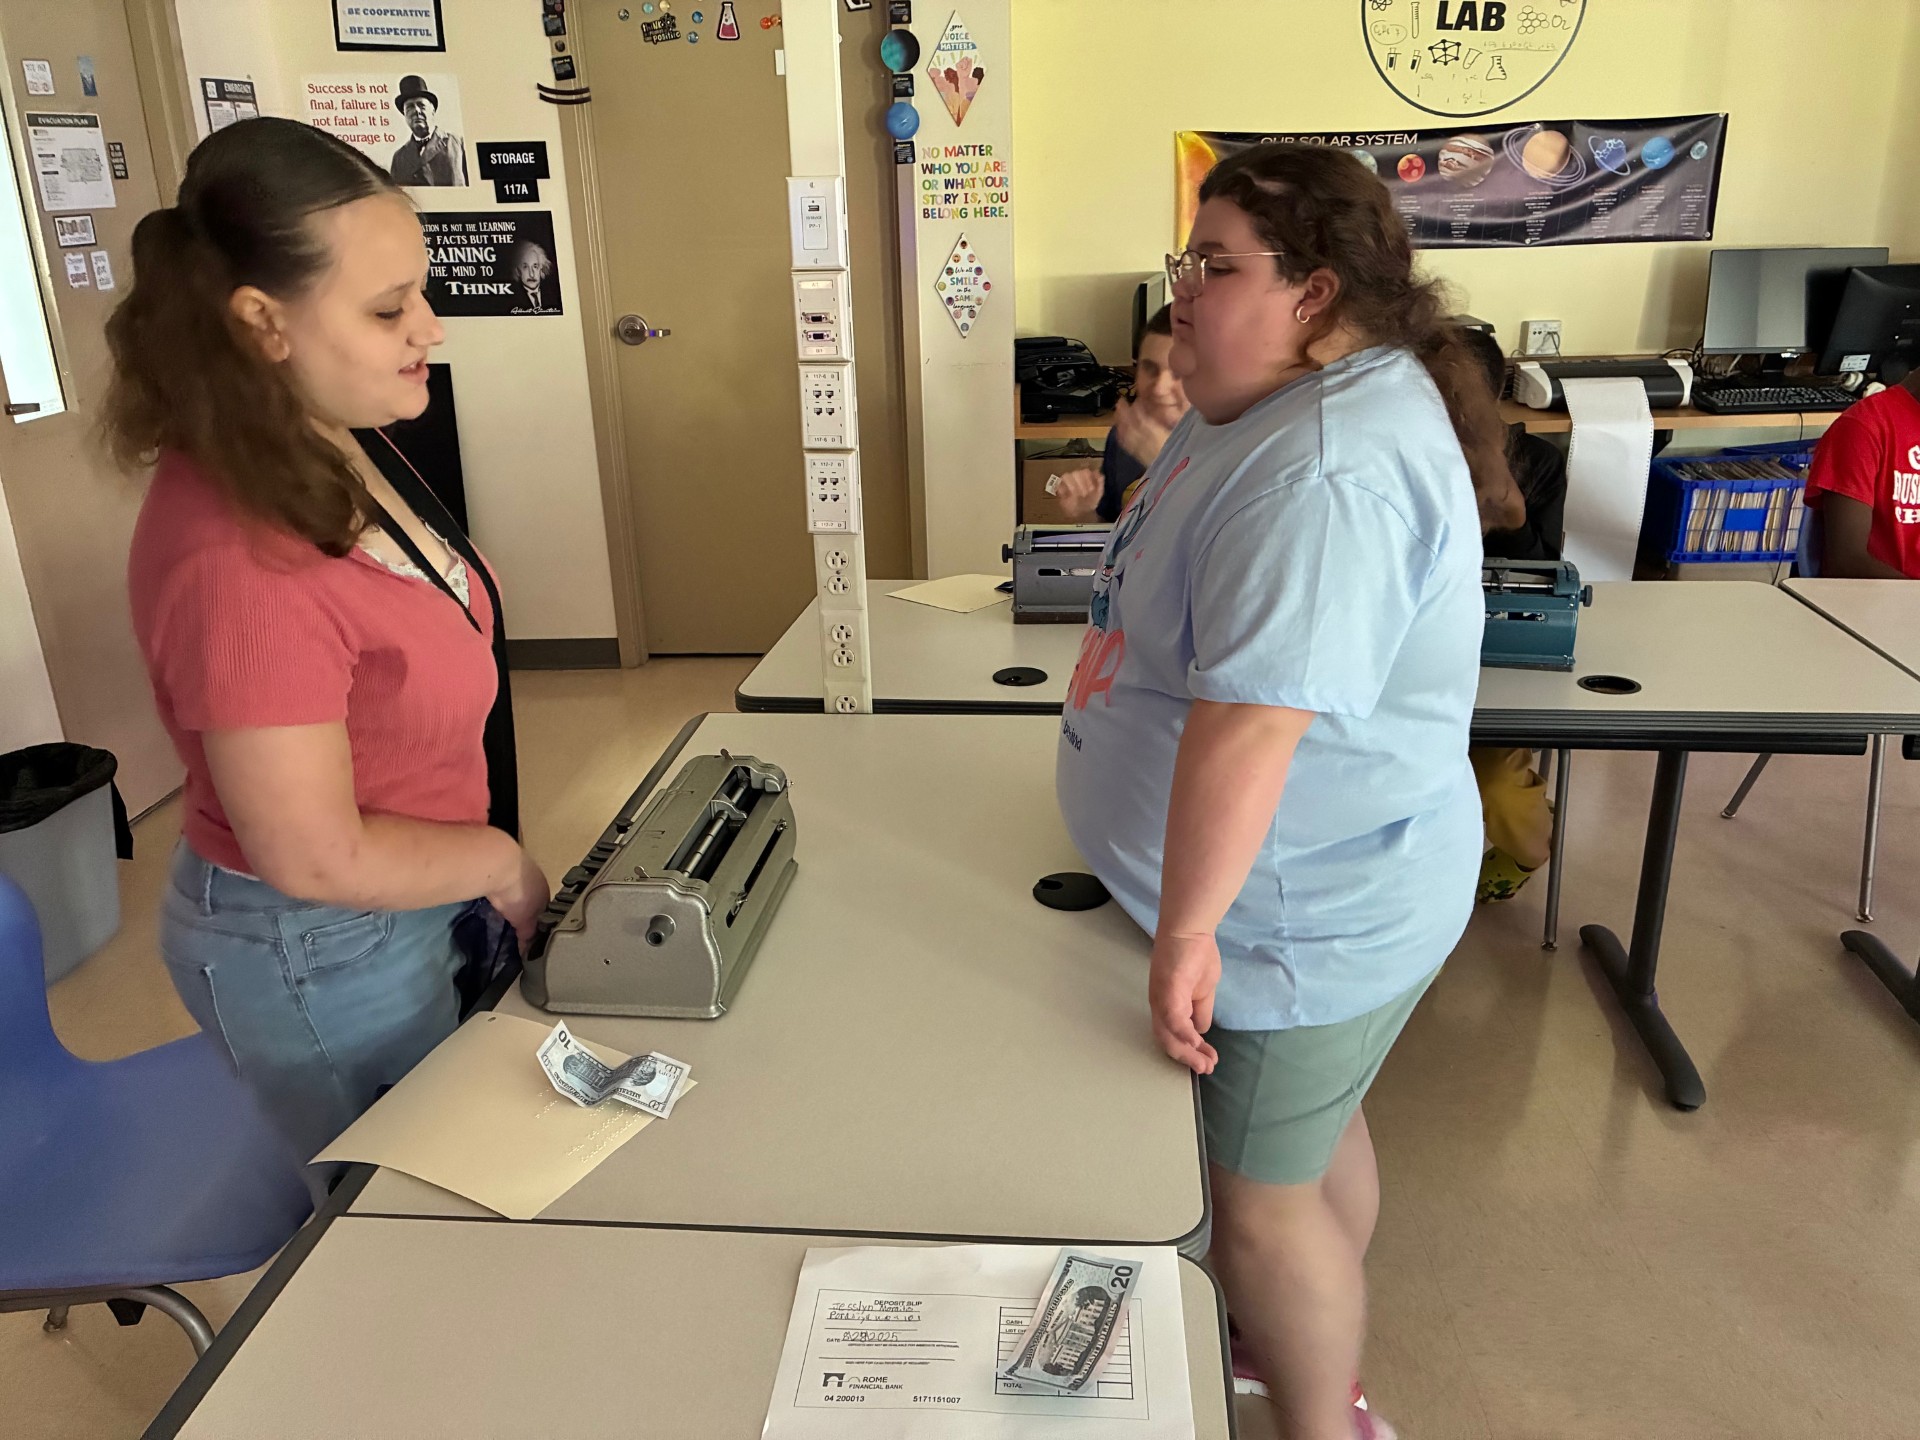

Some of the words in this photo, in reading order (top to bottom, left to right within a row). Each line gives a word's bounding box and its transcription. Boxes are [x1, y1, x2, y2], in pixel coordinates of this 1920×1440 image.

[348, 7, 360, 16] BE
[362, 8, 430, 17] COOPERATIVE
[1436, 0, 1506, 31] LAB
[349, 26, 364, 34] BE
[366, 27, 432, 37] RESPECTFUL
[944, 32, 970, 40] VOICE
[940, 42, 973, 50] MATTERS
[307, 83, 353, 94] Success
[356, 83, 366, 94] is
[369, 83, 388, 94] not
[310, 99, 338, 110] final,
[341, 99, 377, 110] failure
[380, 99, 390, 110] is
[38, 116, 73, 124] EVACUATION
[312, 117, 331, 126] not
[334, 116, 358, 126] fatal
[368, 116, 376, 126] It
[380, 116, 390, 126] is
[336, 134, 380, 145] courage
[384, 132, 396, 143] to
[1300, 136, 1351, 147] SOLAR
[1354, 133, 1418, 146] SYSTEM
[922, 147, 940, 159] NO
[944, 144, 992, 158] MATTER
[490, 152, 535, 164] STORAGE
[921, 163, 951, 174] WHO
[956, 162, 979, 174] YOU
[984, 161, 1007, 172] ARE
[922, 180, 938, 190] OR
[944, 178, 976, 190] WHAT
[979, 176, 1009, 188] YOUR
[504, 184, 529, 195] 117A
[922, 193, 959, 205] STORY
[964, 192, 981, 204] IS,
[984, 191, 1009, 204] YOU
[923, 208, 968, 219] BELONG
[974, 206, 1008, 218] HERE.
[442, 224, 449, 232] IS
[450, 224, 463, 232] NOT
[466, 224, 476, 232] THE
[479, 222, 516, 232] LEARNING
[436, 235, 468, 245] FACTS
[470, 234, 488, 244] BUT
[491, 234, 514, 244] THE
[428, 247, 496, 263] RAINING
[430, 266, 448, 276] THE
[452, 266, 476, 276] MIND
[480, 266, 494, 276] TO
[950, 276, 978, 286] SMILE
[445, 281, 514, 295] THINK
[558, 1030, 570, 1050] 10
[1110, 1265, 1133, 1290] 20
[913, 1396, 961, 1404] 5171151007
